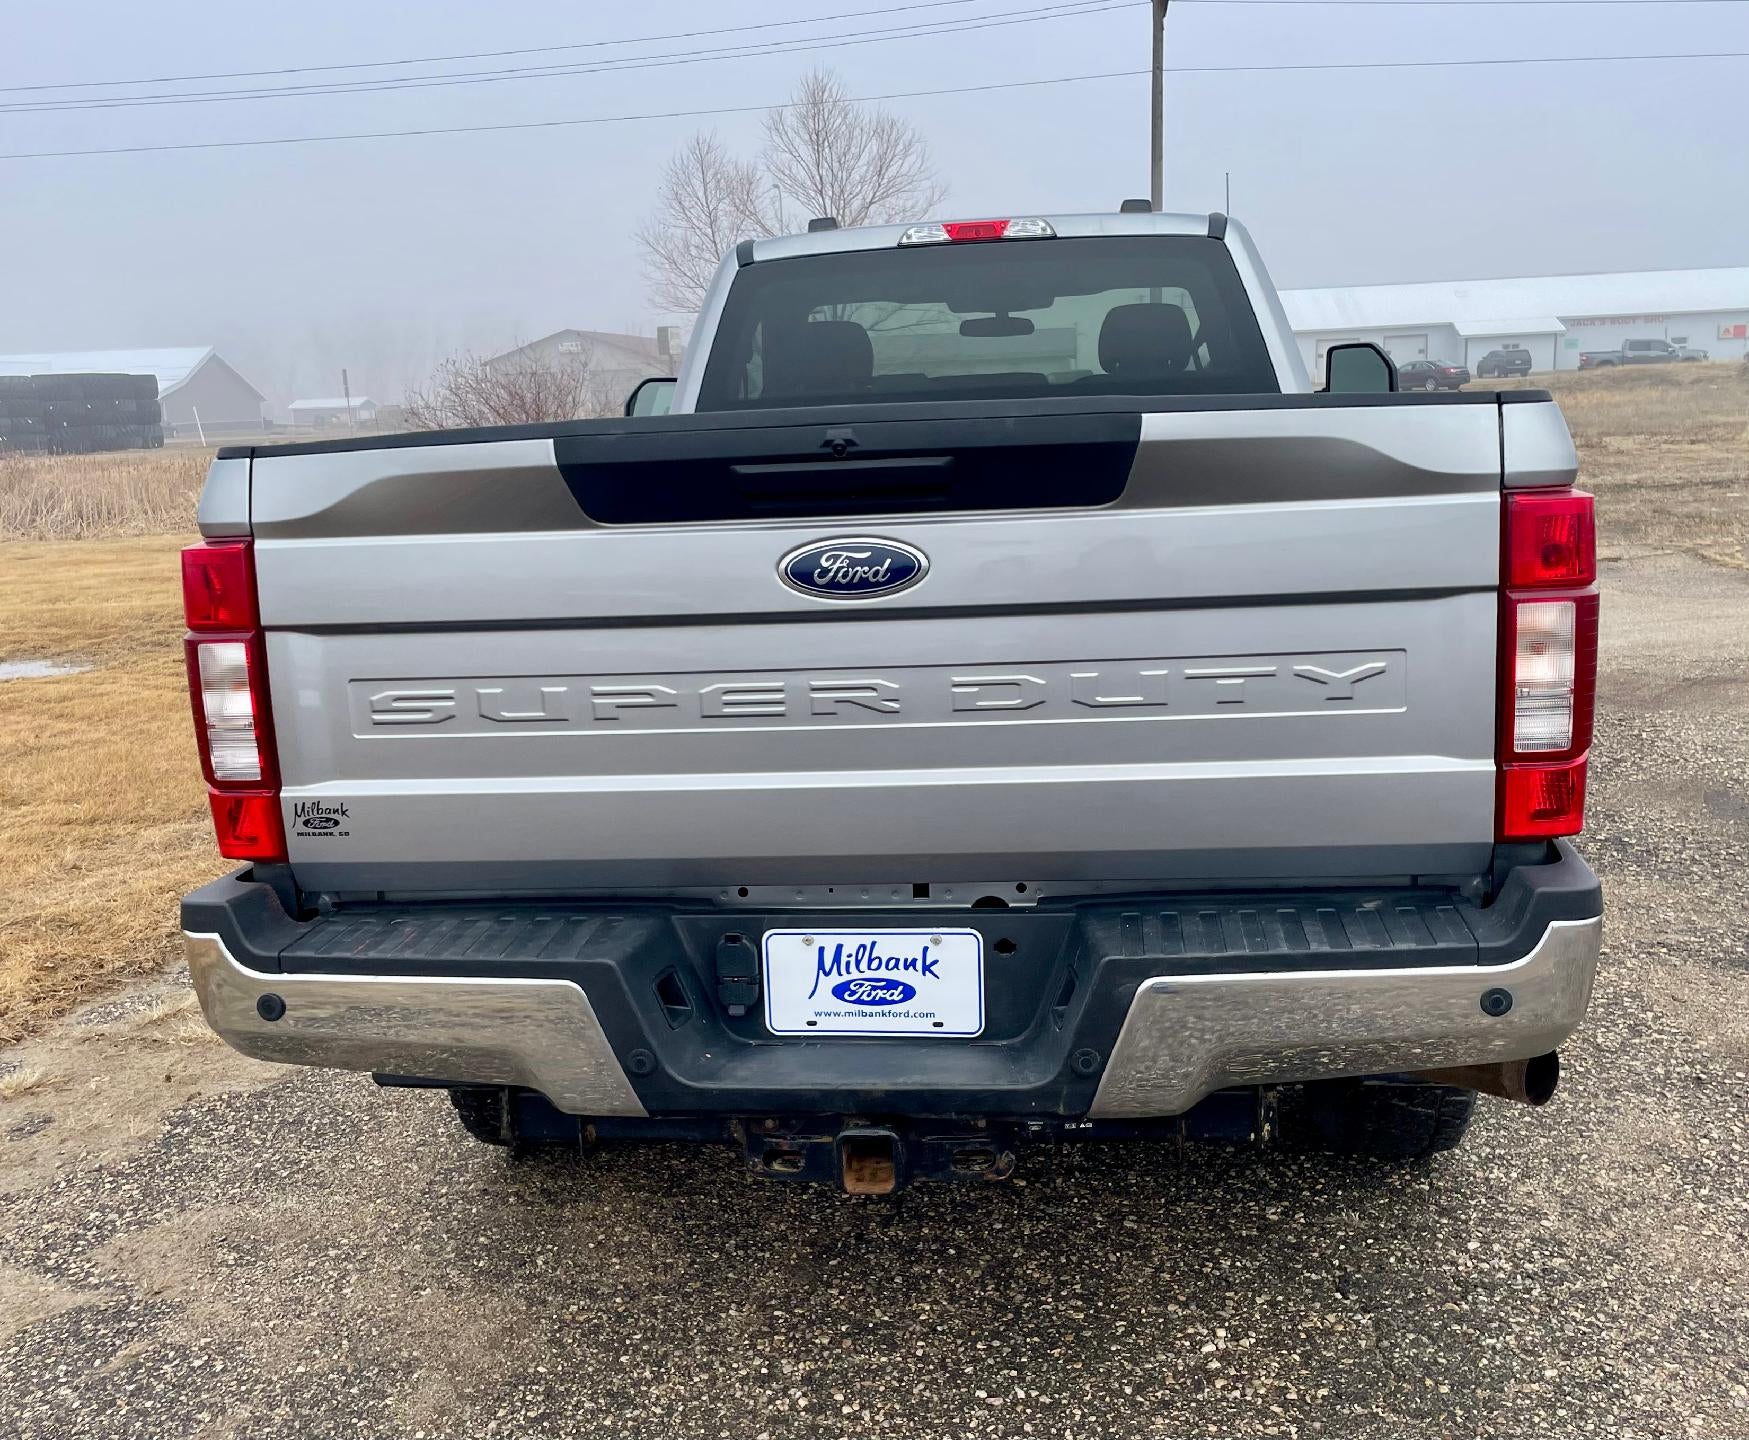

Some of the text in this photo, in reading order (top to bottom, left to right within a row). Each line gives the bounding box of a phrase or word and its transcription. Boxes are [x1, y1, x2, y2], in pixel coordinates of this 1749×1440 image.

[813, 551, 892, 585] Ford
[370, 662, 1387, 726] SUPER DUTY
[292, 800, 350, 828] Milbank
[307, 817, 335, 828] Ford
[808, 940, 940, 1000] Milbank
[843, 980, 904, 1001] Ford
[814, 1009, 936, 1019] www.milbankford.com
